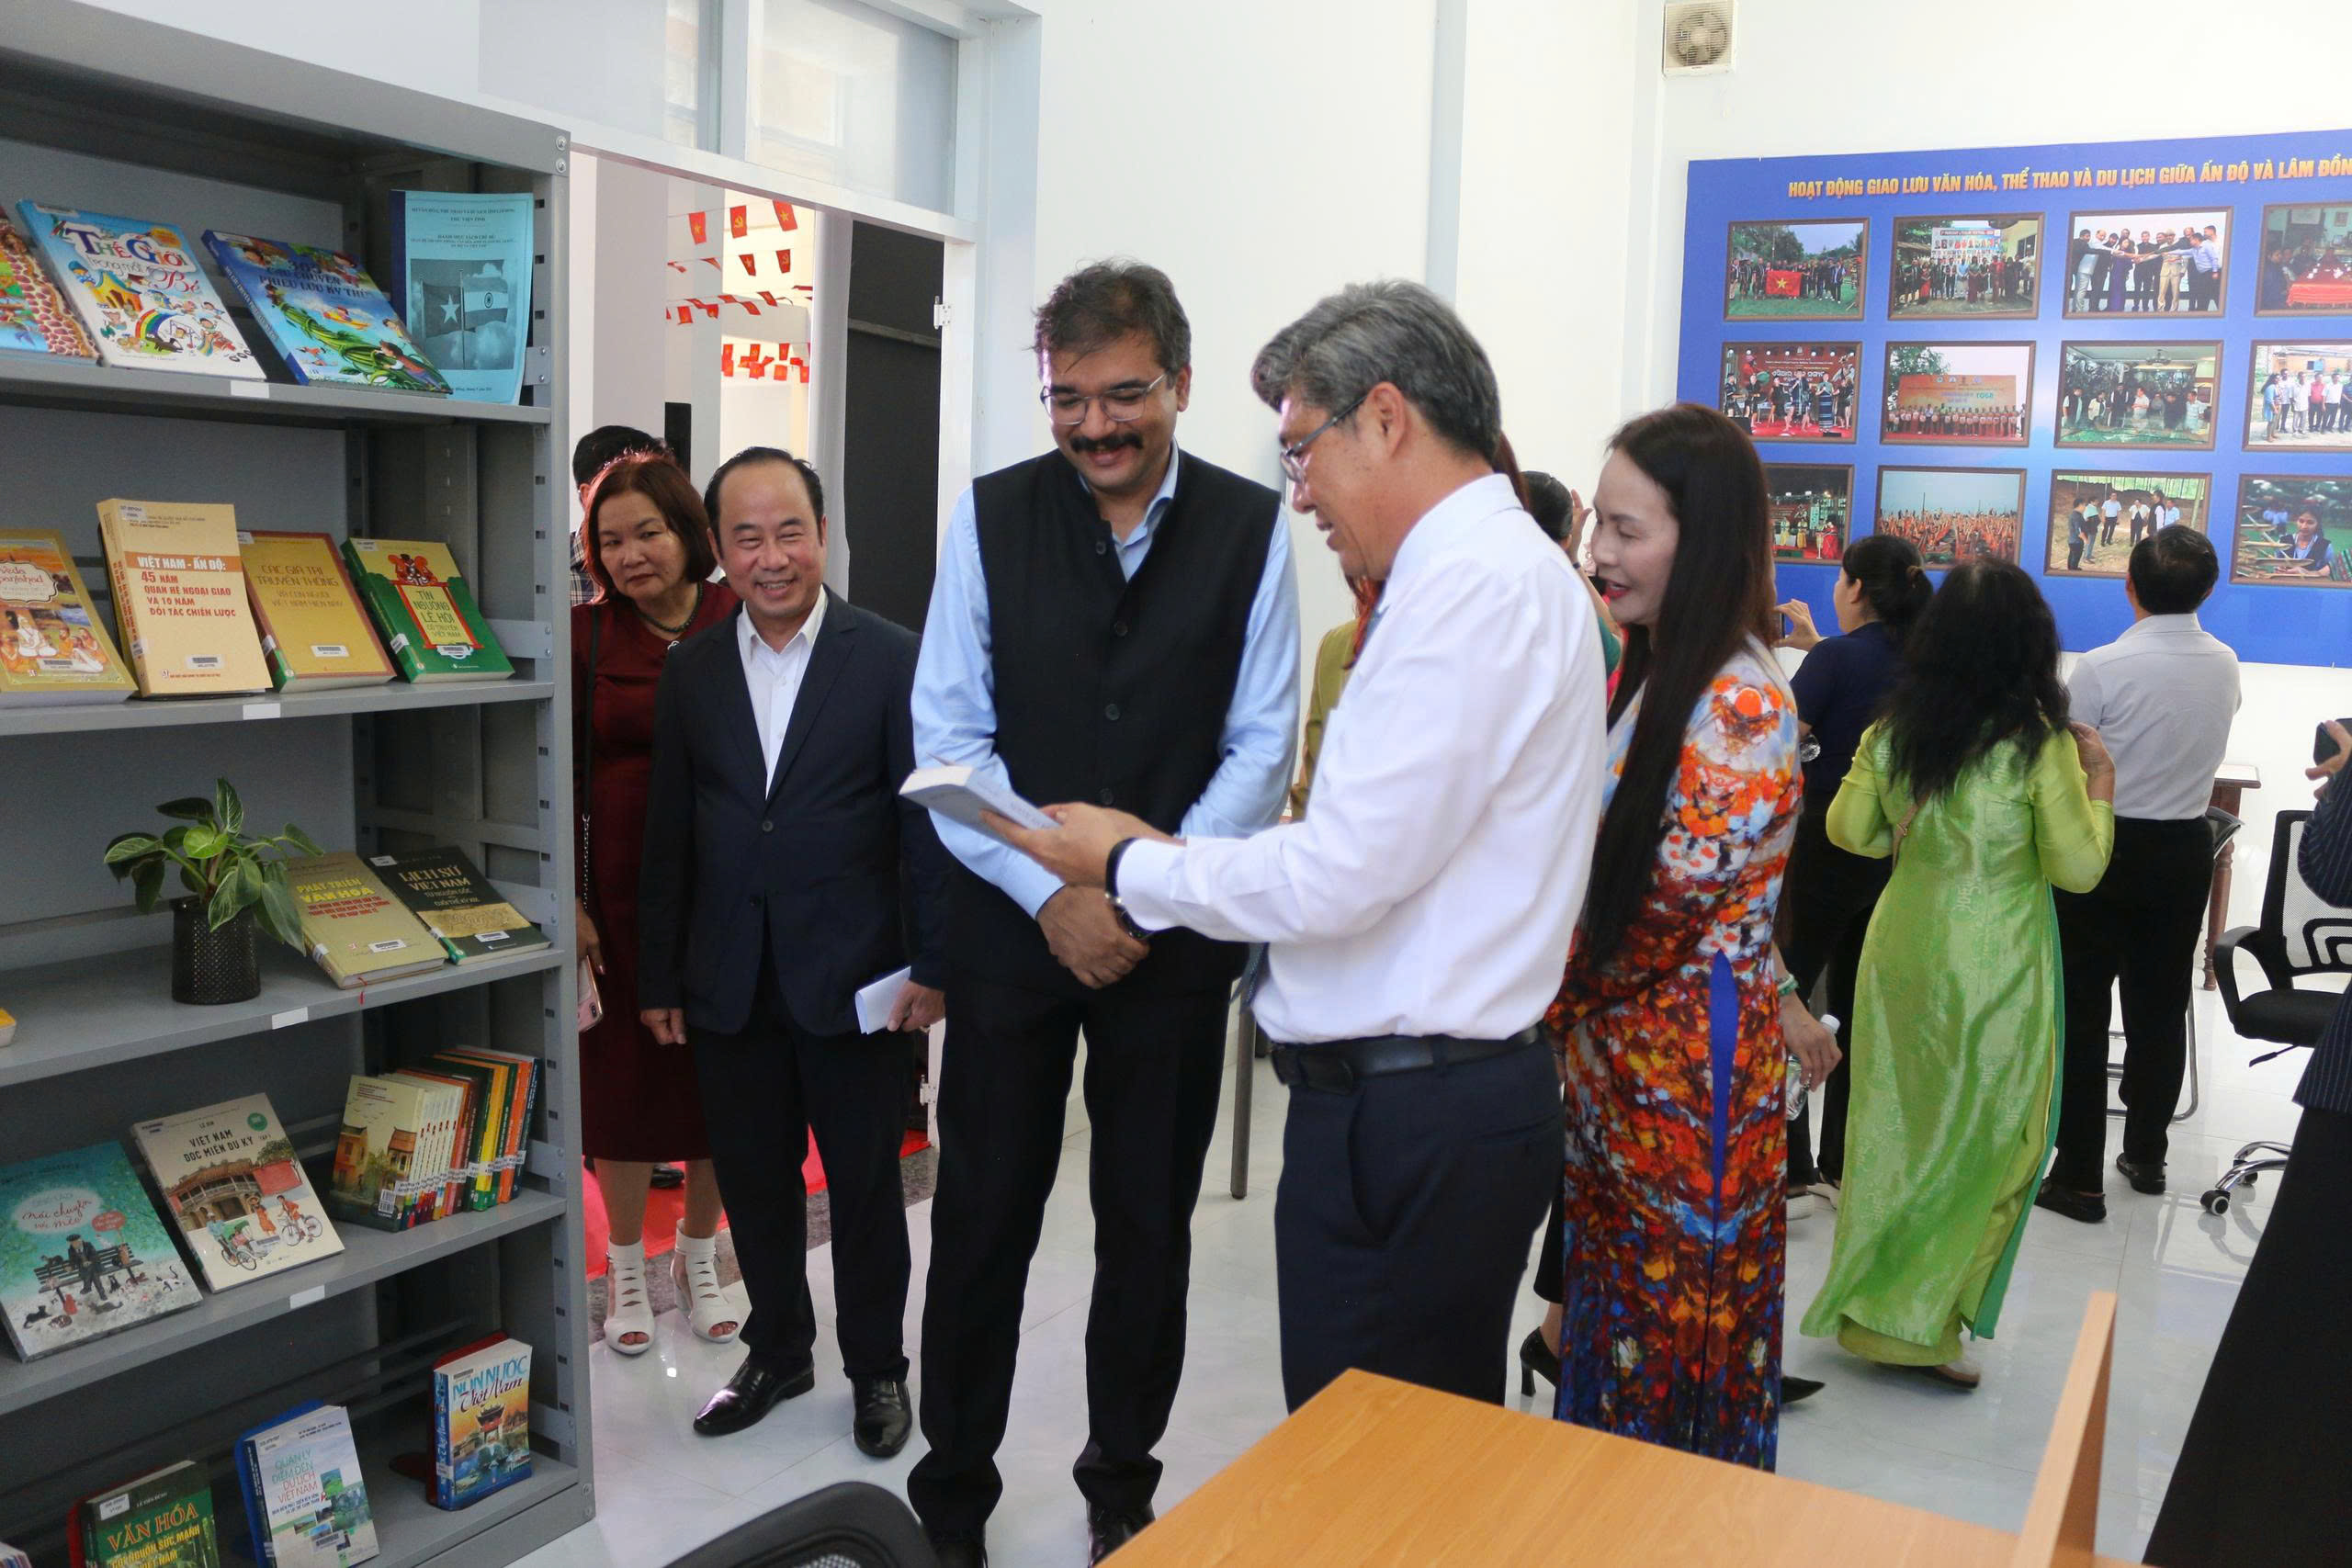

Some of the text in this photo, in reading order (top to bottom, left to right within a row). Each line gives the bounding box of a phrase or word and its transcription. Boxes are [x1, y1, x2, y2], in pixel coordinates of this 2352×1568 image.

[1788, 181, 1823, 200] HOẠT
[1826, 176, 1863, 199] ĐỘNG
[1867, 178, 1899, 196] GIAO
[1903, 175, 1929, 194] LƯU
[1932, 173, 1961, 192] VĂN
[1964, 172, 1997, 192] HÓA,
[2002, 167, 2030, 190] THỂ
[2032, 171, 2069, 189] THAO
[2074, 167, 2093, 187] VÀ
[2097, 169, 2118, 186] DU
[2120, 167, 2155, 188] LỊCH
[2159, 163, 2196, 184] GIỮA
[2199, 160, 2223, 182] ẤN
[2226, 161, 2249, 184] ĐỘ
[2254, 160, 2274, 180] VÀ
[2278, 158, 2314, 178] LÂM
[137, 555, 160, 570] VIỆT
[163, 558, 186, 570] NAM
[193, 556, 208, 570] ẤN
[141, 571, 156, 583] 45
[144, 585, 167, 595] QUAN
[183, 586, 209, 596] NGOẠI
[211, 587, 232, 596] GIAO
[440, 876, 471, 888] NAM
[213, 1129, 233, 1143] NAM
[227, 1141, 240, 1152] DU
[487, 1378, 522, 1402] Nam
[295, 1481, 318, 1498] NAM
[107, 1519, 152, 1552] VĂN
[154, 1502, 199, 1535] HÓA
[175, 1524, 200, 1545] MẠNH
[158, 1550, 177, 1565] NAM
